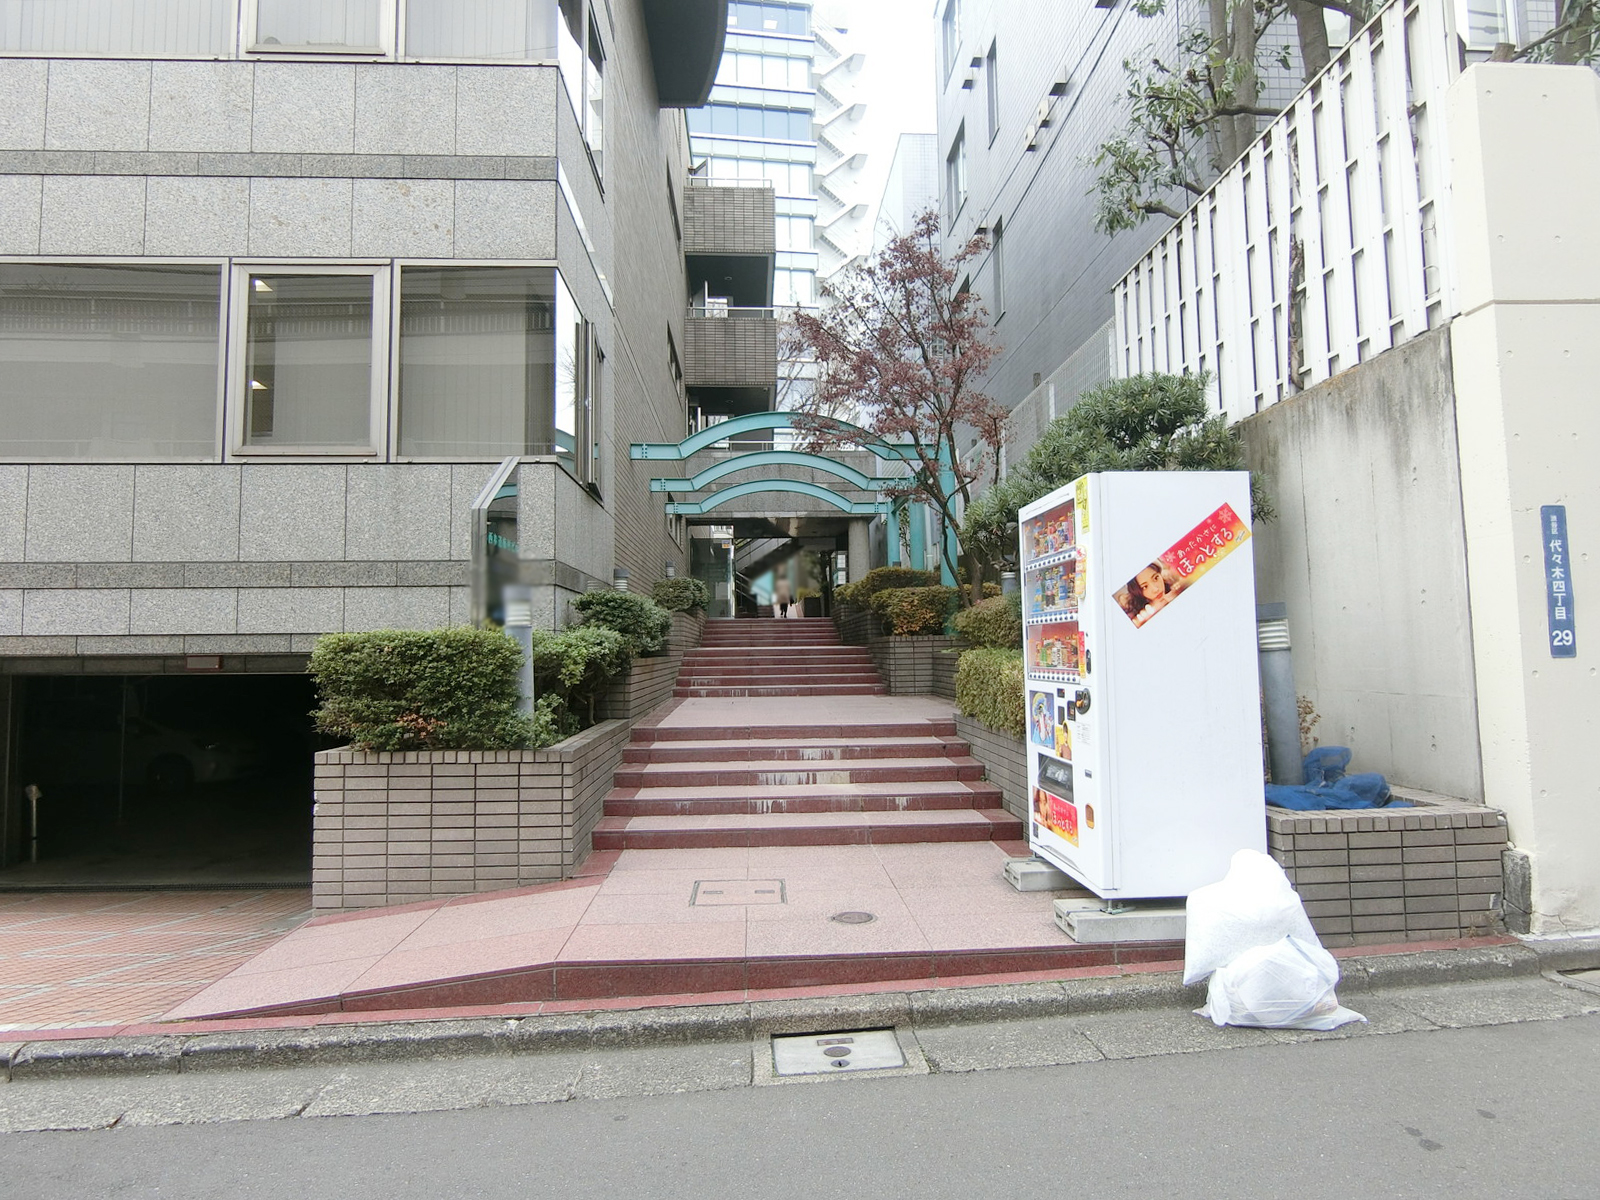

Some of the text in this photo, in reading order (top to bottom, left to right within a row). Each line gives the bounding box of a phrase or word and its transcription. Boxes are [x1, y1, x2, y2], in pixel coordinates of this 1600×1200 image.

[1177, 527, 1233, 577] ほっとする
[1549, 539, 1566, 620] 代々木四丁目
[1552, 629, 1573, 646] 29
